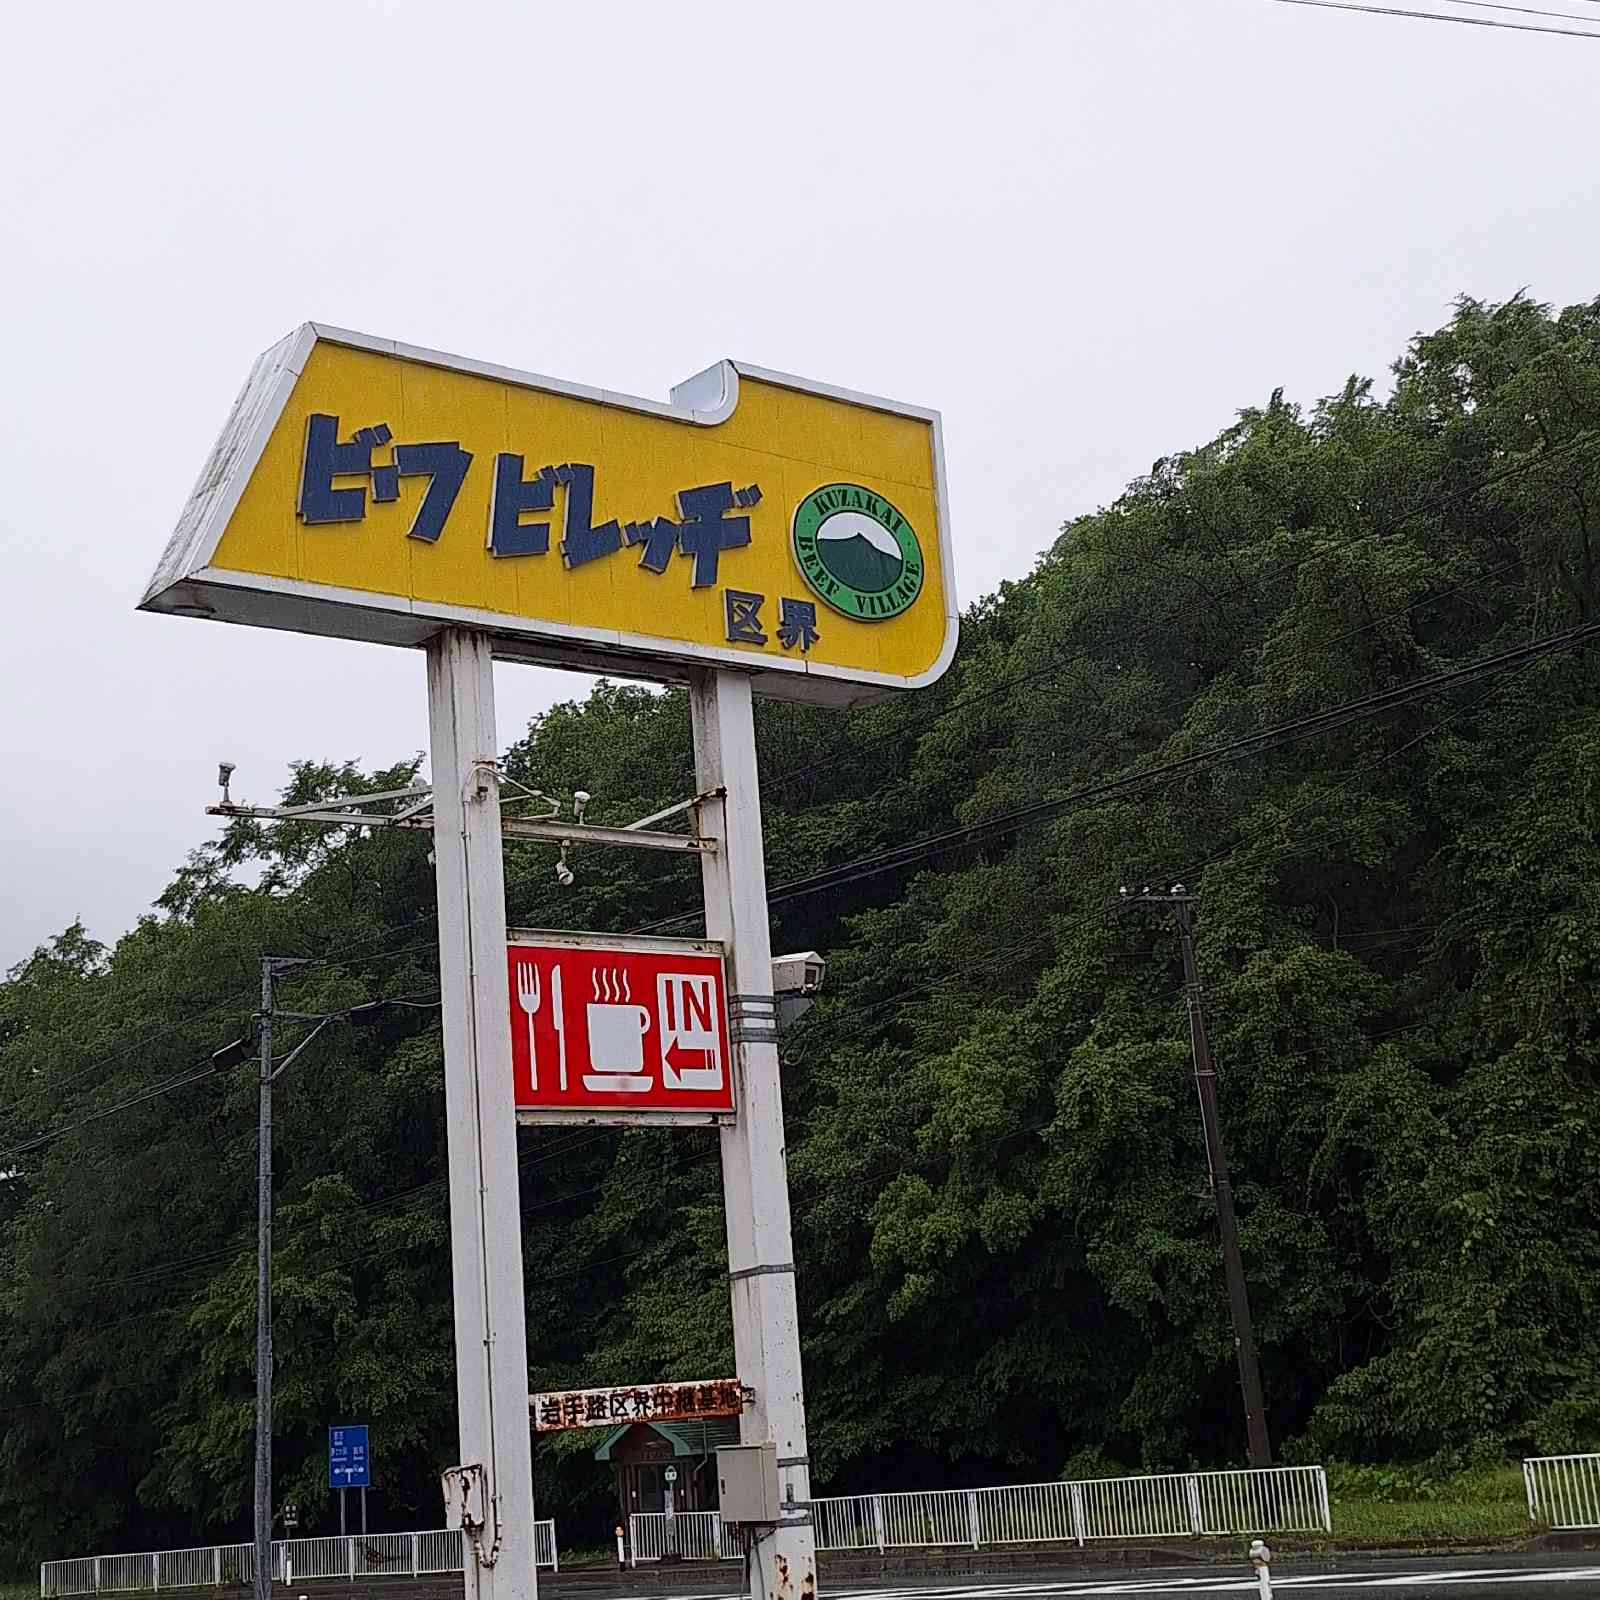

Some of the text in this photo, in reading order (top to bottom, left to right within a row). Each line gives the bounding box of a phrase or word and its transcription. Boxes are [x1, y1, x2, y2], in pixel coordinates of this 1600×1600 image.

[812, 489, 904, 532] KUZAKAI
[798, 535, 840, 596] BEEF
[853, 560, 920, 615] VILLAGE
[723, 588, 820, 653] 区界
[664, 979, 713, 1032] IN
